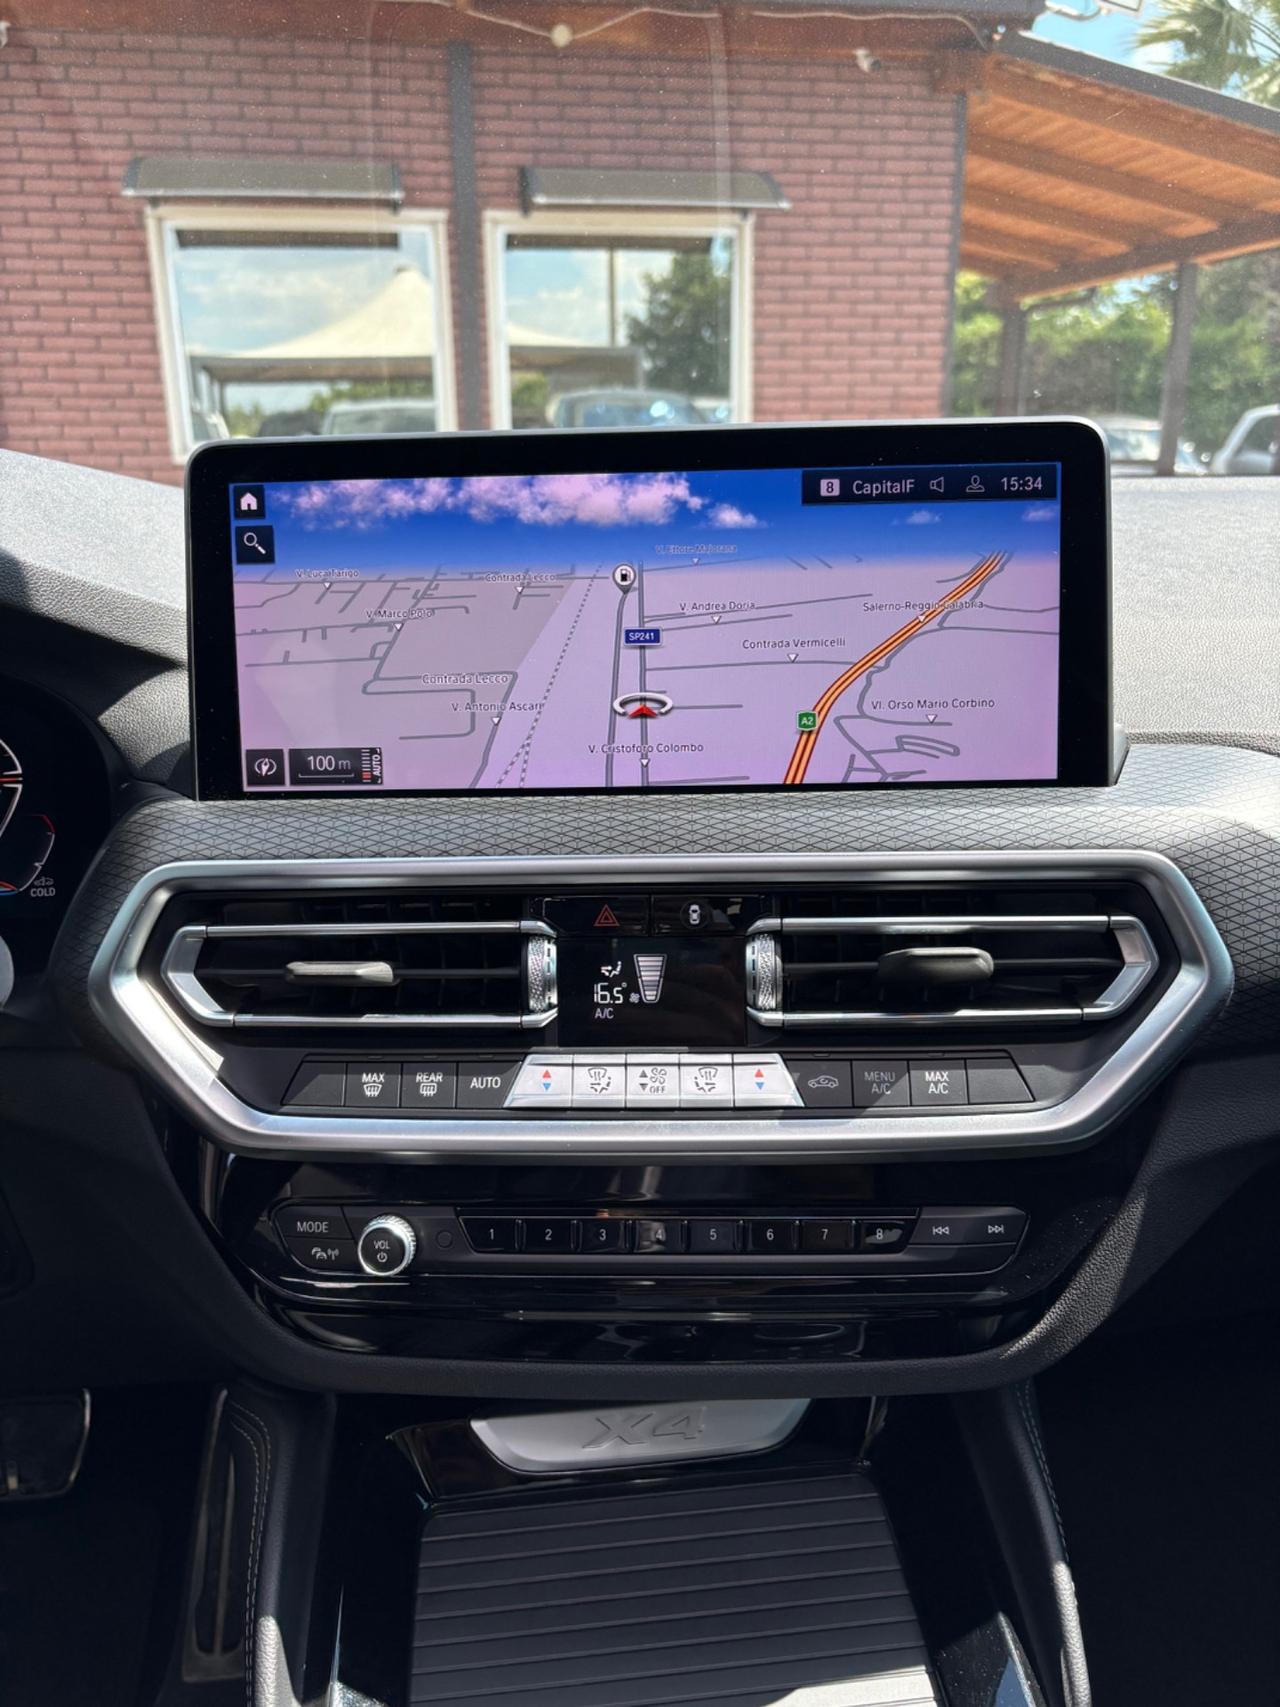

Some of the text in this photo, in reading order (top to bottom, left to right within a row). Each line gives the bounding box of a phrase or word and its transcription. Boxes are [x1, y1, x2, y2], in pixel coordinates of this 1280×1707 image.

[825, 480, 834, 494] 8
[852, 479, 915, 497] CapitalF
[1000, 476, 1043, 491] 15:34
[680, 601, 756, 611] V. Andrea Doria
[863, 602, 941, 612] Salerno-Reggio
[378, 609, 408, 618] Marco
[629, 632, 655, 641] SP241
[742, 637, 846, 649] Contrada Vermicelli
[422, 673, 509, 684] Contrada Lecco
[451, 703, 462, 711] V.
[465, 702, 506, 712] Antonio
[888, 700, 914, 710] Orso
[917, 699, 949, 710] Mario
[952, 698, 995, 709] Corbino
[801, 717, 814, 726] A2
[588, 745, 598, 753] V.
[656, 743, 704, 753] Colombo
[308, 755, 351, 771] 100 m
[372, 754, 382, 776] AUTO
[30, 887, 56, 897] COLD
[594, 1008, 614, 1019] A/C
[362, 1073, 385, 1083] MAX
[416, 1072, 443, 1083] REAR
[864, 1072, 895, 1082] MENU
[925, 1071, 949, 1082] MAX
[470, 1077, 500, 1089] AUTO
[871, 1083, 891, 1095] A/C
[928, 1083, 948, 1094] A/C
[649, 1086, 665, 1094] OFF
[297, 1221, 329, 1233] MODE
[489, 1228, 495, 1240] 1
[545, 1228, 552, 1241] 2
[600, 1228, 606, 1241] 3
[655, 1228, 664, 1241] 4
[709, 1228, 717, 1241] 5
[766, 1228, 774, 1241] 6
[821, 1228, 828, 1241] 7
[876, 1228, 883, 1241] 8
[374, 1240, 390, 1250] VOL
[582, 1407, 706, 1450] X4
